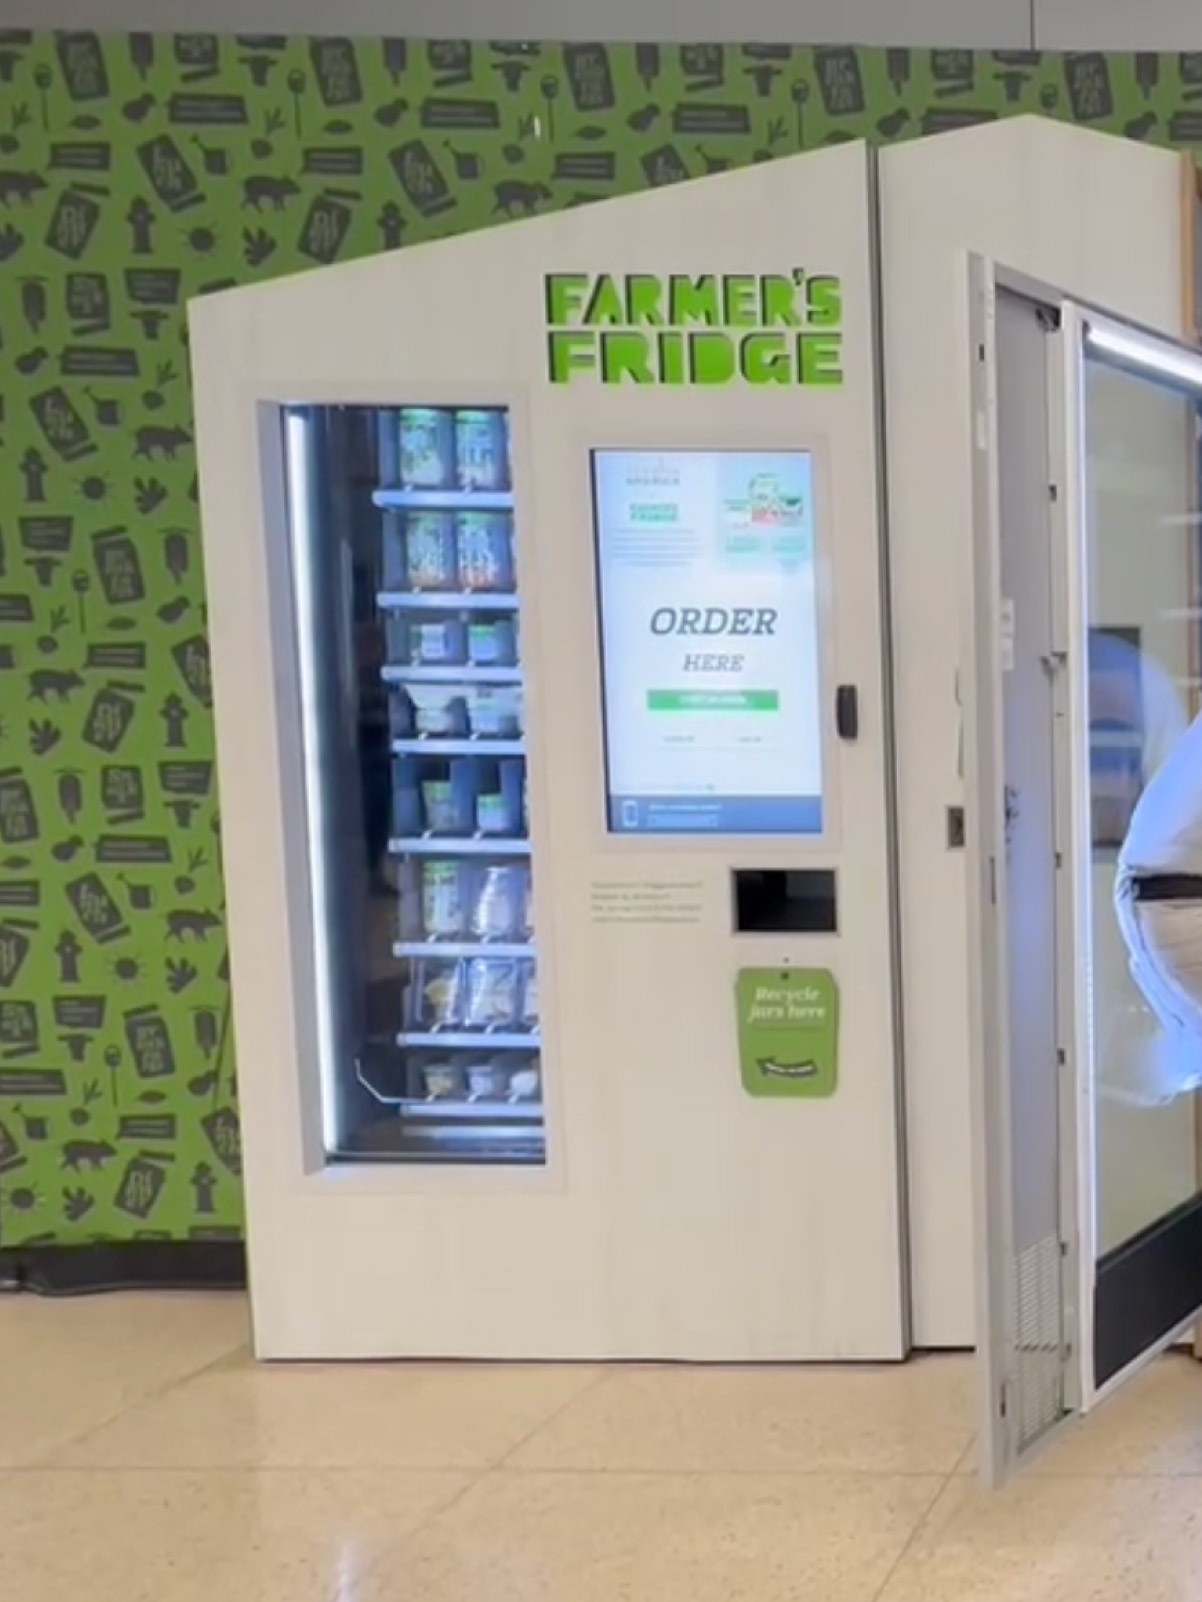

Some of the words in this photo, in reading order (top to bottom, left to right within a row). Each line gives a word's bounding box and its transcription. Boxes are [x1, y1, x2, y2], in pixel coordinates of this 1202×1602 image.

[545, 268, 841, 326] FARMER'S
[548, 331, 842, 384] FRIDGE
[650, 607, 778, 635] ORDER
[682, 653, 745, 672] HERE
[754, 986, 820, 1007] Recycle
[747, 1004, 784, 1023] jars
[787, 1003, 827, 1019] here
